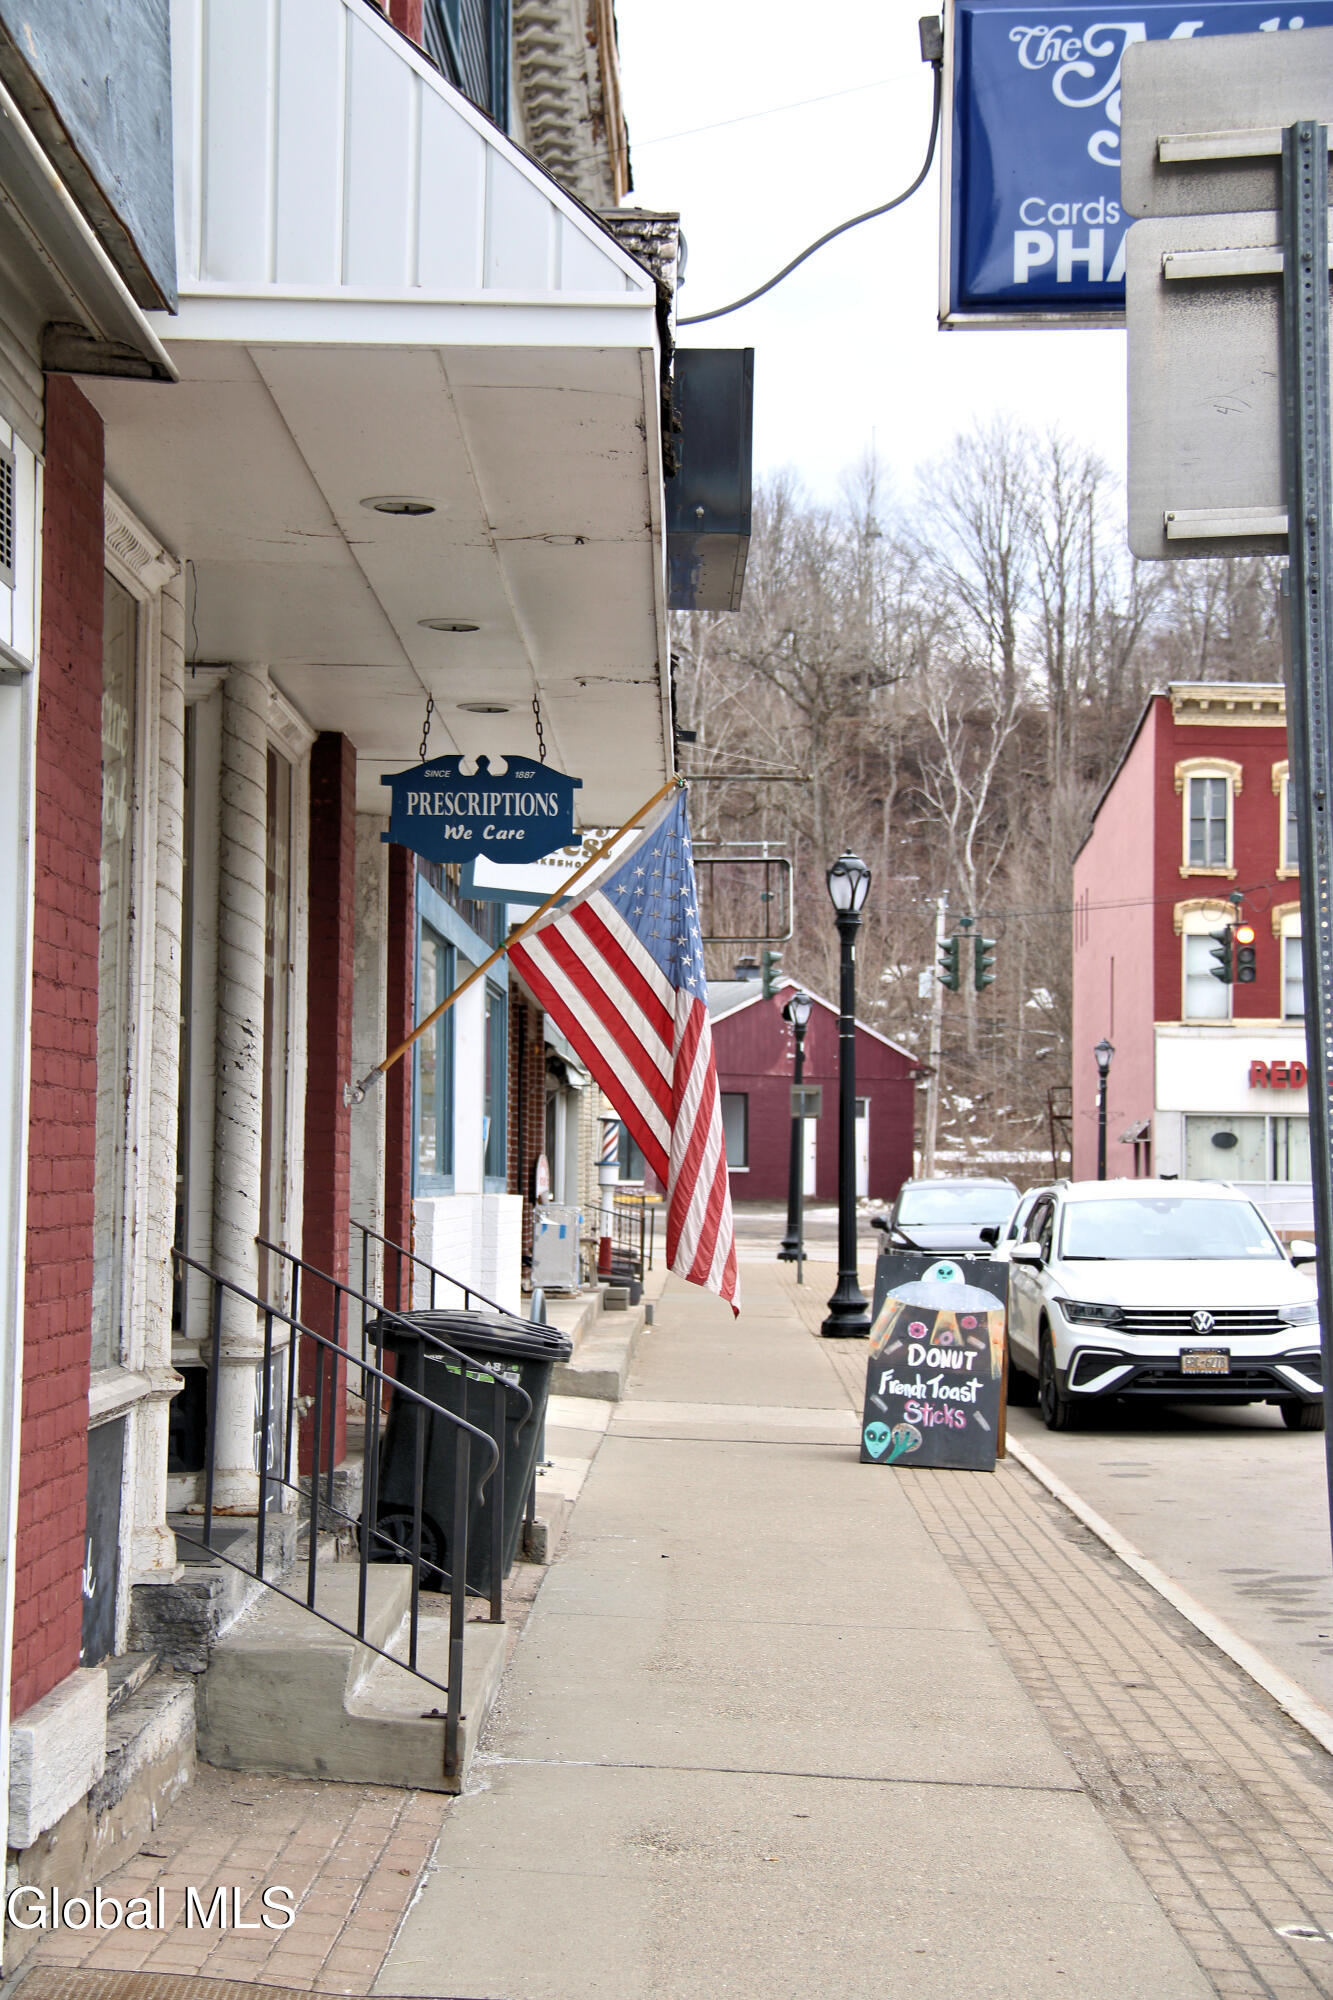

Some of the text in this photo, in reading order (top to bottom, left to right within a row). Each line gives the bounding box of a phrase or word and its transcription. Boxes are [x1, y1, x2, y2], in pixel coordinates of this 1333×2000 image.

[1009, 24, 1083, 70] The
[1019, 196, 1121, 226] Cards
[424, 769, 536, 779] SINCE 1887
[407, 792, 559, 817] PRESCRIPTIONS
[444, 824, 525, 840] We Care
[907, 1343, 978, 1371] DONUT
[878, 1368, 984, 1403] French Toast
[903, 1399, 967, 1429] Sticks
